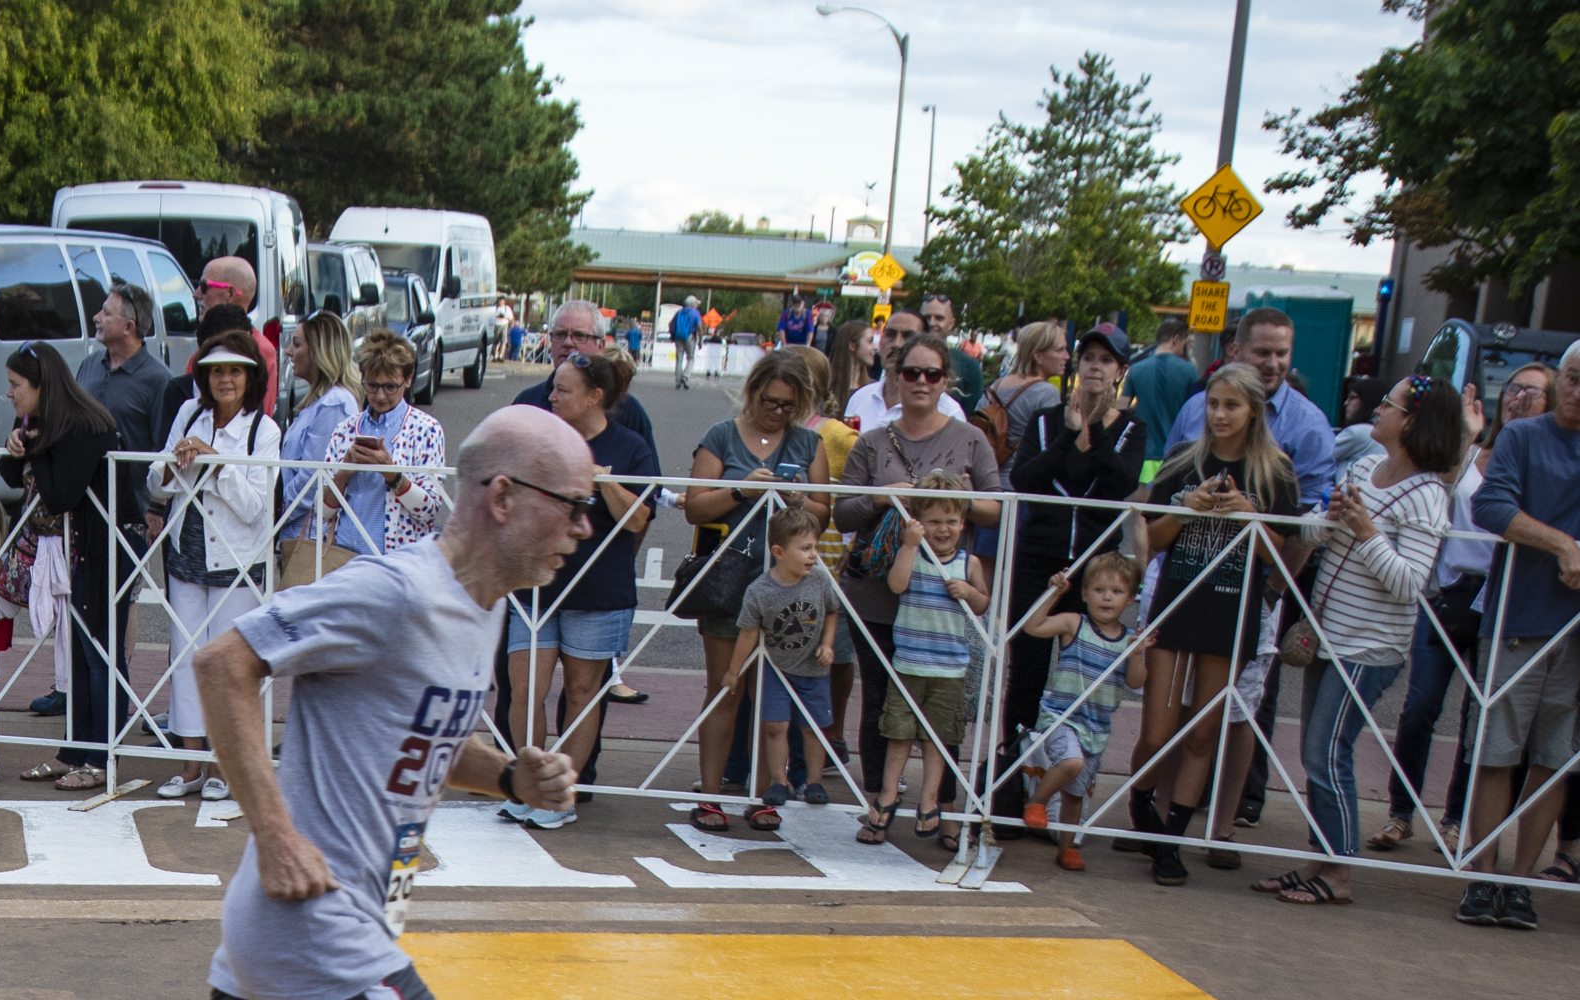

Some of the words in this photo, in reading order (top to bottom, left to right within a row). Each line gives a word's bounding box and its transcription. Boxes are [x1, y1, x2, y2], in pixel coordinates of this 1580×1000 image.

[1196, 286, 1227, 297] SHARE
[1201, 301, 1218, 312] THE
[1194, 314, 1220, 326] ROAD
[777, 601, 815, 621] PINK
